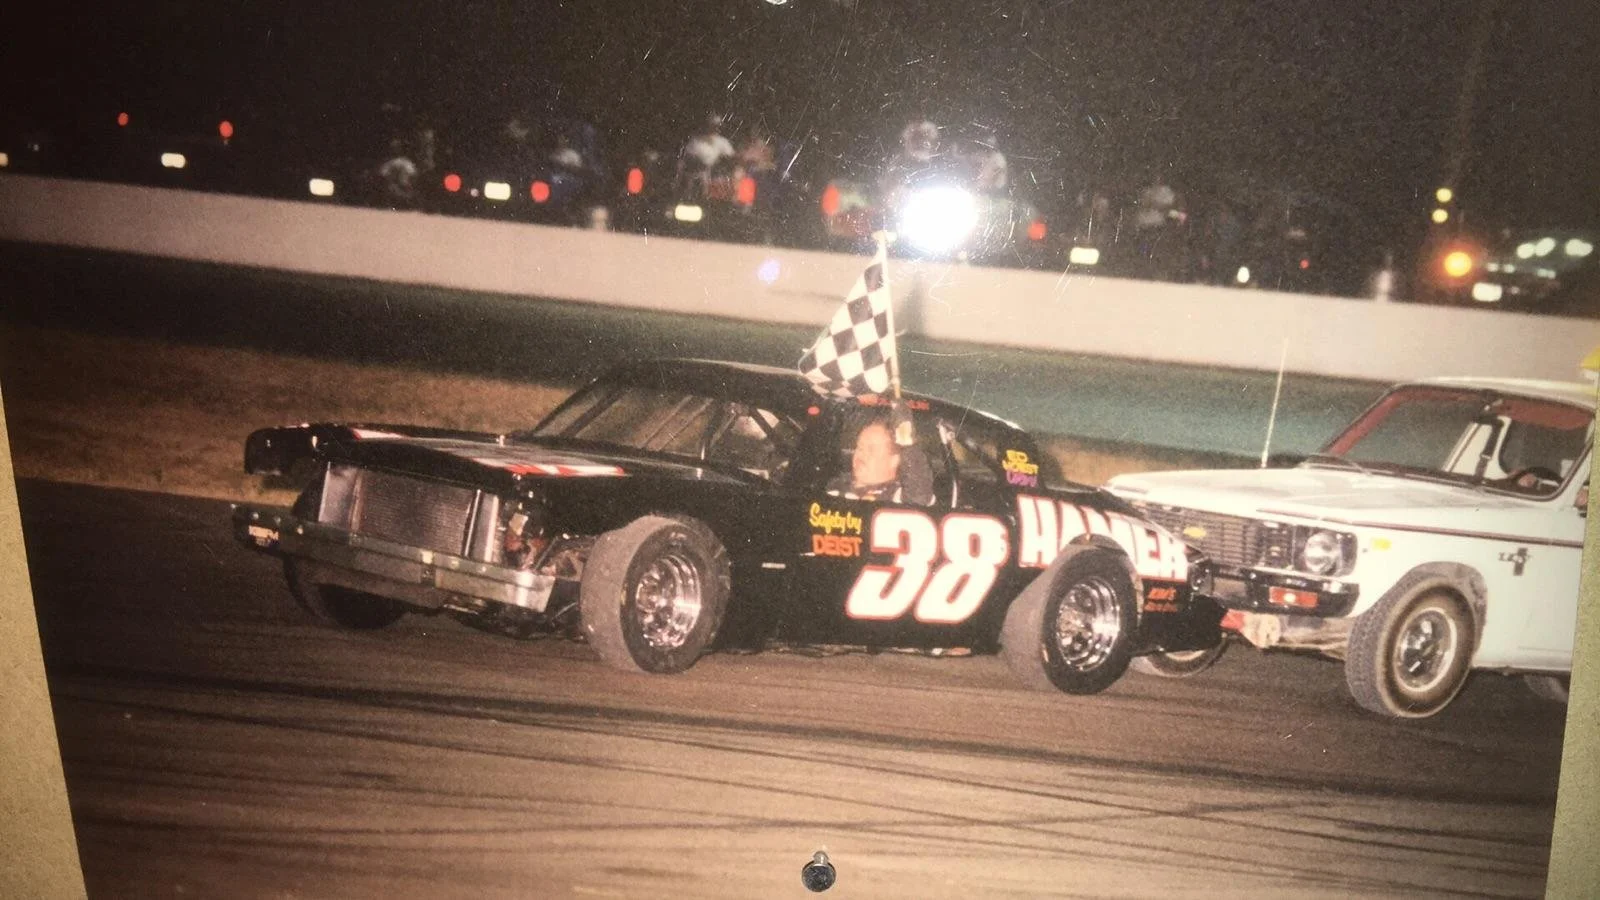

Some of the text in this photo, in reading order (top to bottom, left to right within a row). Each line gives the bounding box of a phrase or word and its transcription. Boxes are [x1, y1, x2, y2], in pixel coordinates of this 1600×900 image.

[809, 502, 862, 535] Safety by
[812, 534, 863, 557] DEIST
[844, 508, 1011, 625] 38
